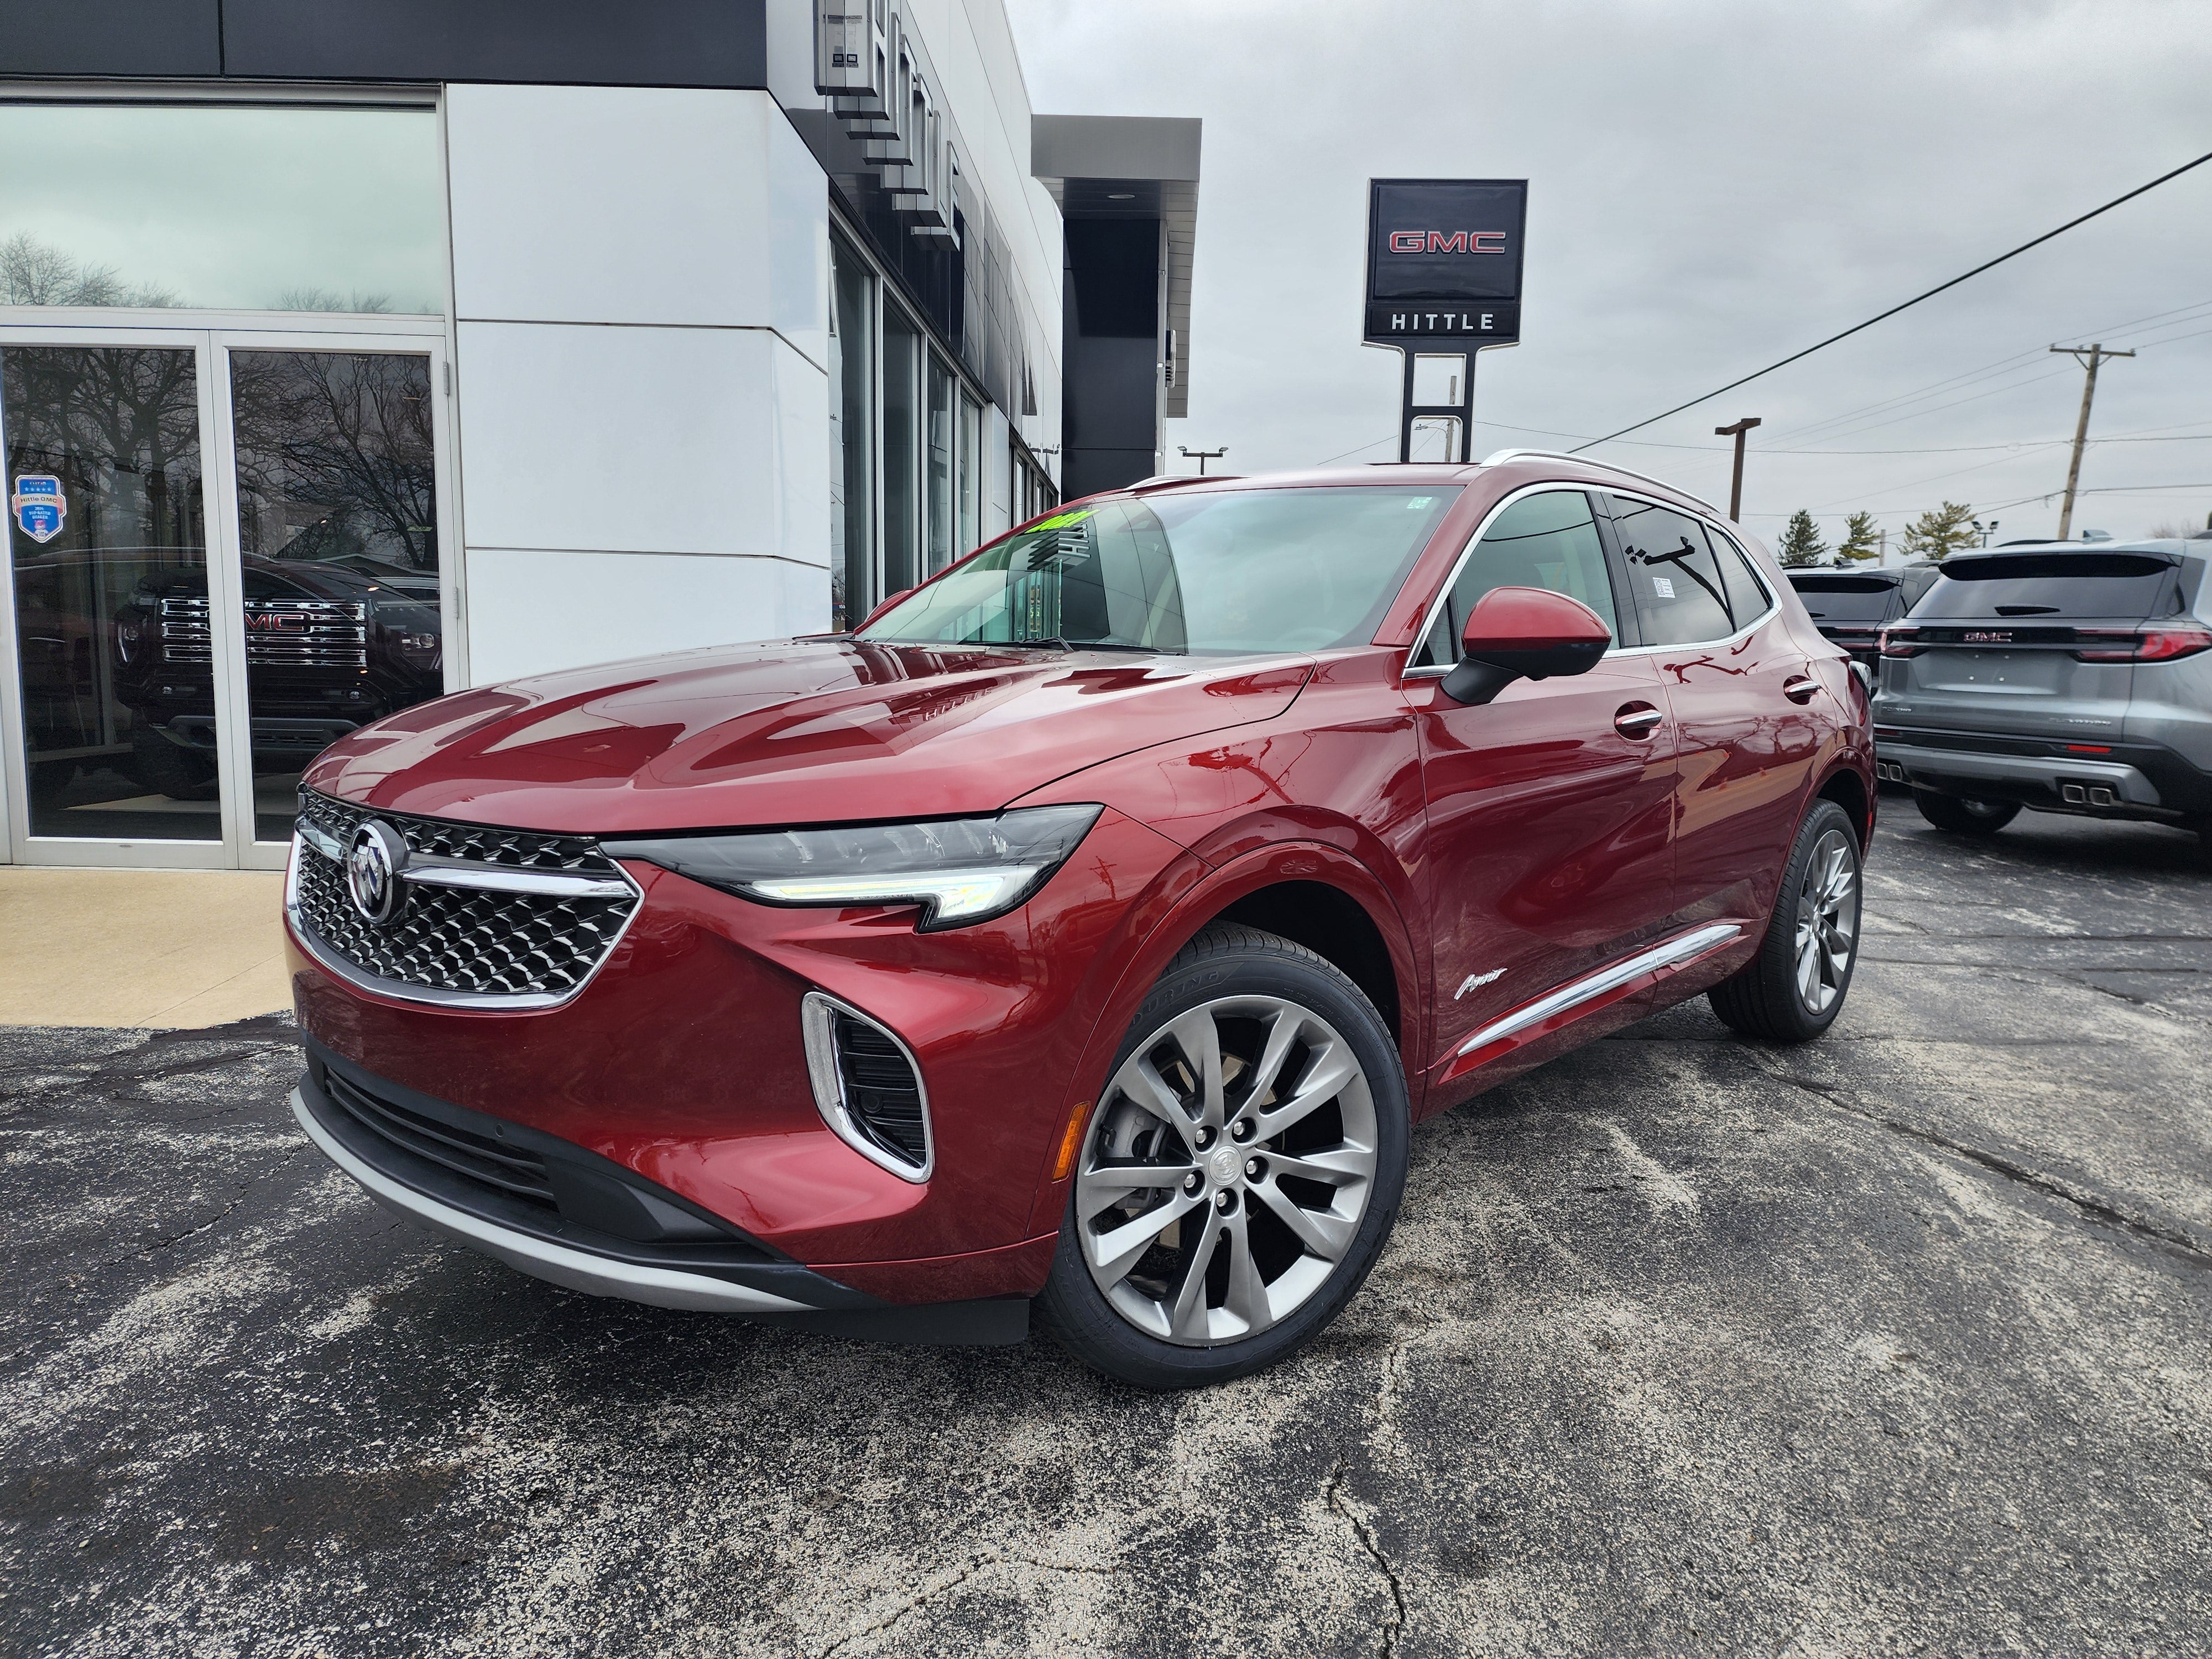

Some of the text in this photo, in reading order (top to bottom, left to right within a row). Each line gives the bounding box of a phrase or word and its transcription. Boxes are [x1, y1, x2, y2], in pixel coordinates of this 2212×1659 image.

[1389, 231, 1506, 253] GMC
[1391, 314, 1493, 330] HITTLE
[245, 613, 305, 631] MC
[1964, 632, 2013, 643] GMC
[1130, 970, 1219, 1026] OURING
